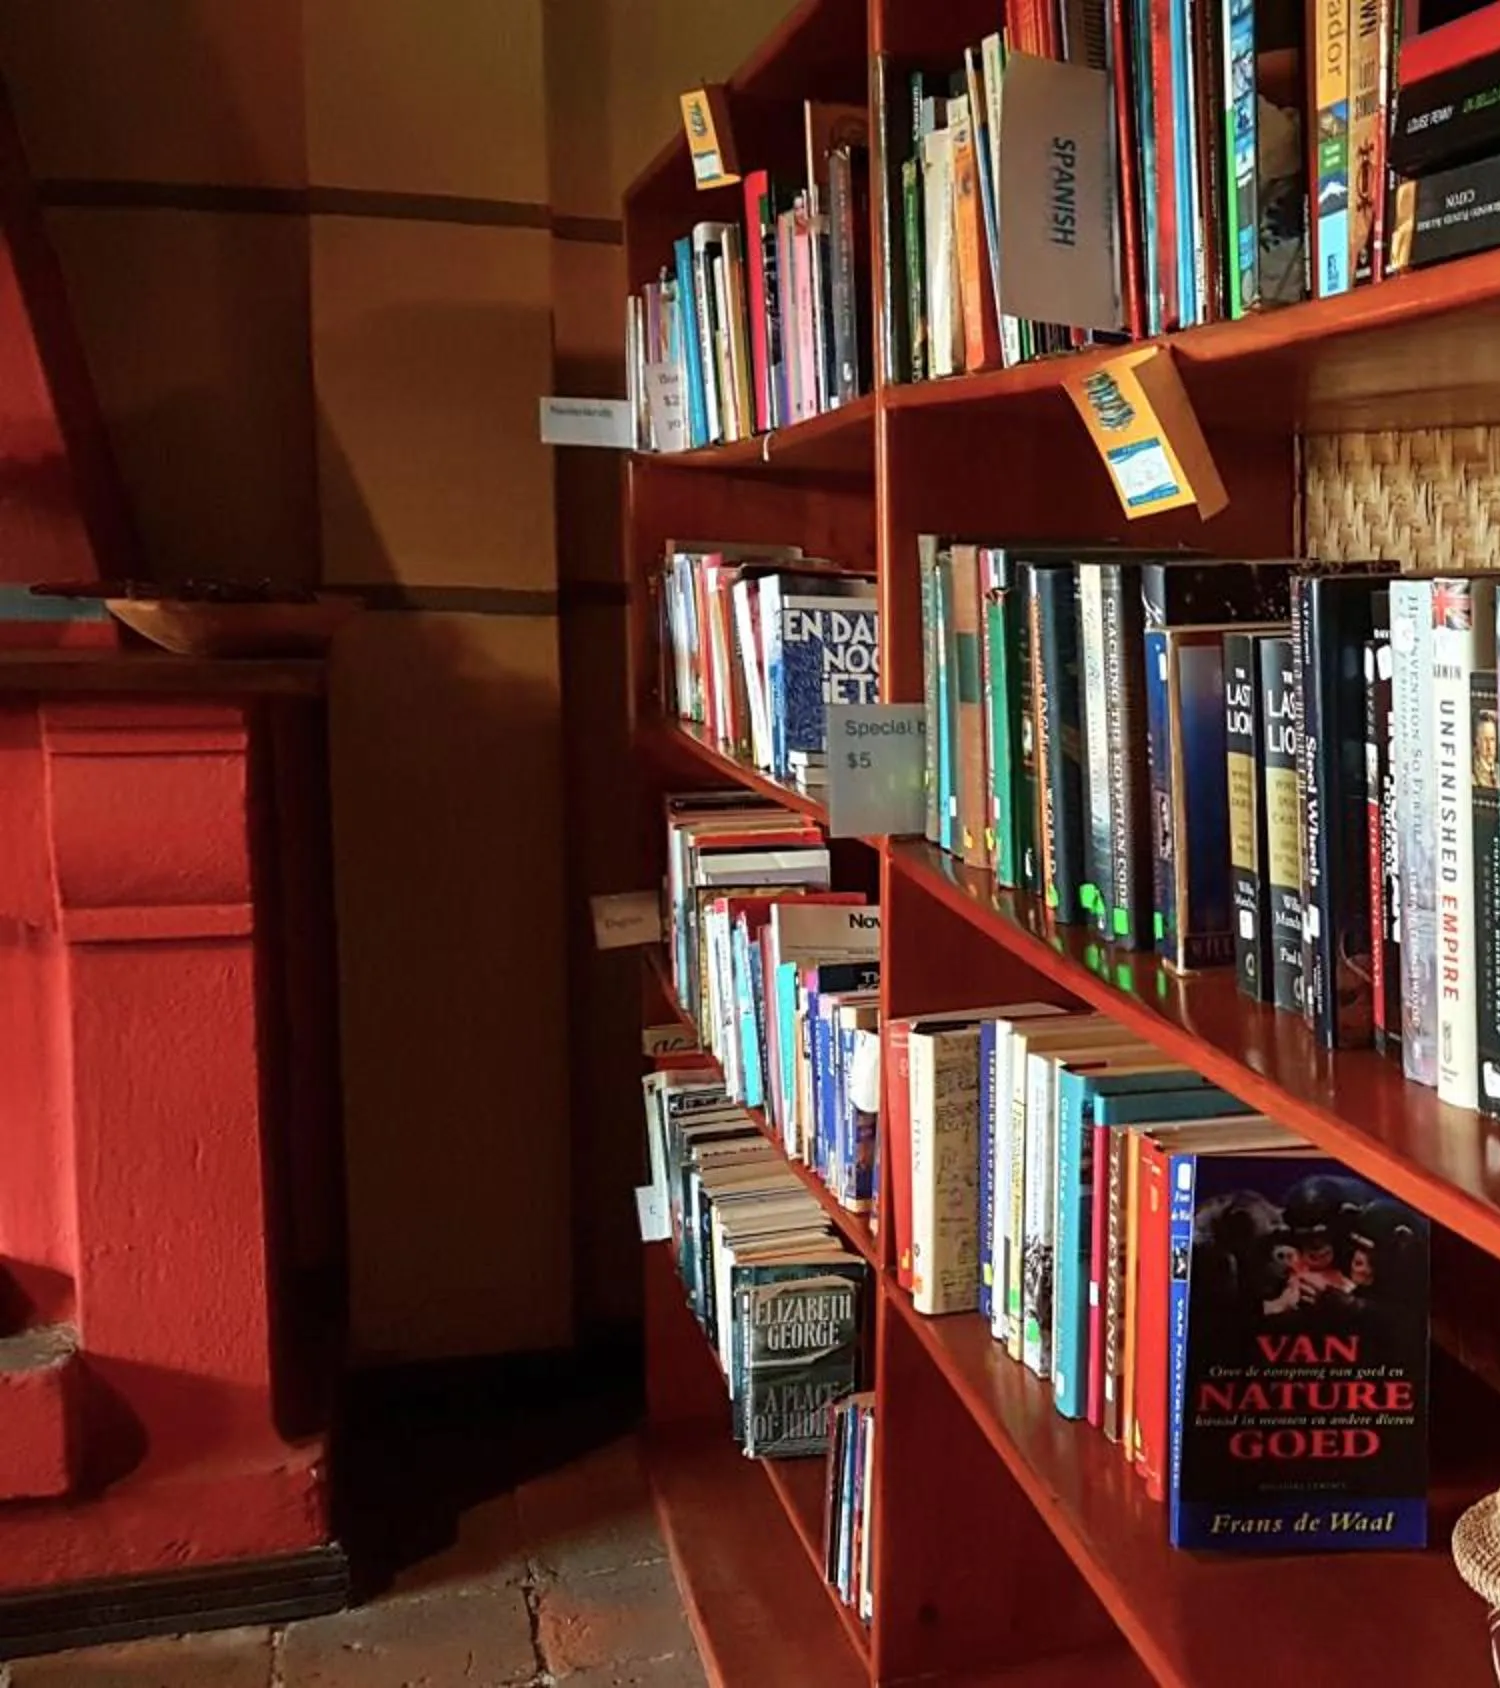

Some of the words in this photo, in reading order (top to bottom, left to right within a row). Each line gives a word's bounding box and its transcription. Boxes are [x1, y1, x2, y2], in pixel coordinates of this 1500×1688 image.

[1051, 135, 1077, 248] SPANISH
[783, 611, 823, 641] EN
[1107, 597, 1121, 700] CRACKING
[1267, 689, 1297, 720] LAS
[845, 719, 913, 738] Special
[1267, 724, 1297, 755] LIO
[847, 750, 872, 769] $5
[1305, 735, 1318, 795] Steel
[1113, 751, 1127, 854] EGYPTIAN
[1439, 700, 1458, 883] UNFINISHED
[1307, 799, 1321, 886] Wheels
[1117, 857, 1128, 909] CODE
[1442, 894, 1460, 1002] EMPIRE
[1106, 1153, 1119, 1371] TALLEYRAND
[754, 1294, 852, 1326] ELIZABETH
[767, 1320, 840, 1350] GEORGE
[1256, 1334, 1361, 1364] VAN
[1245, 1365, 1258, 1377] de
[1329, 1367, 1353, 1378] van
[1356, 1364, 1386, 1379] goed
[1388, 1367, 1405, 1377] en
[765, 1386, 778, 1414] A
[1197, 1380, 1415, 1411] NATURE
[752, 1412, 776, 1441] OF
[1241, 1414, 1256, 1426] in
[1311, 1415, 1326, 1426] en
[1329, 1413, 1373, 1426] andere
[1375, 1412, 1416, 1426] dieren
[1229, 1427, 1383, 1460] GOED
[1210, 1513, 1284, 1534] Frans
[1293, 1511, 1321, 1532] de
[1329, 1510, 1396, 1532] Waal
